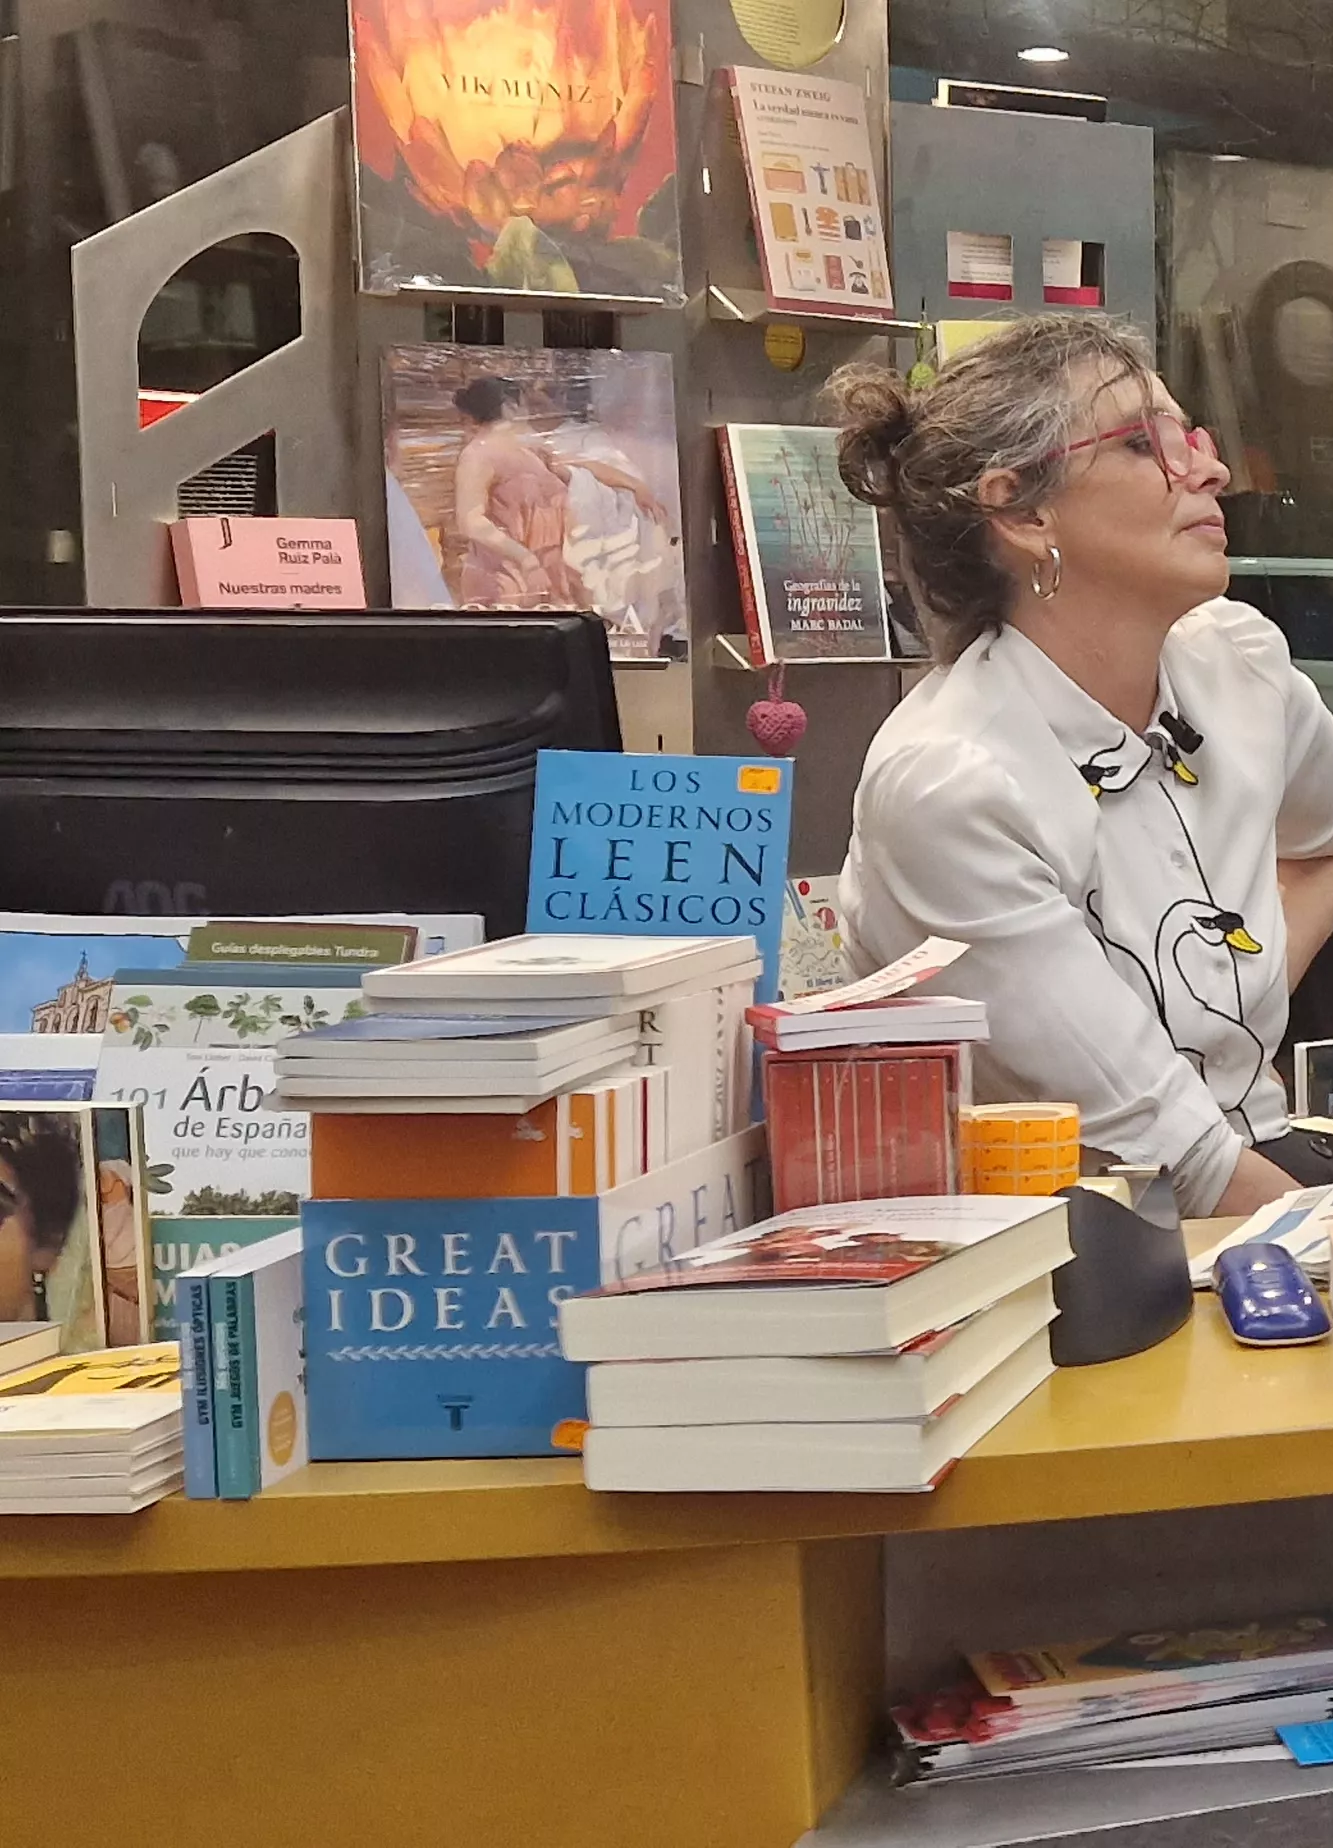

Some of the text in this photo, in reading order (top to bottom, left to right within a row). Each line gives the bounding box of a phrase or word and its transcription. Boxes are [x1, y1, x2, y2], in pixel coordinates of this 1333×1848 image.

[442, 73, 592, 104] VIK MUNIZ
[276, 537, 333, 550] Gemma
[279, 552, 309, 565] Ruiz
[219, 582, 342, 595] Nuestras madres
[787, 594, 863, 616] ingravidez
[791, 620, 864, 631] MARC BADAL
[630, 770, 701, 794] LOS
[552, 801, 772, 832] MODERNOS
[549, 837, 767, 886] LEEN
[545, 886, 766, 926] CLÁSICOS
[334, 944, 379, 958] Tundra
[173, 1116, 307, 1145] de España
[171, 1145, 267, 1162] que hay que
[325, 1229, 579, 1278] GREAT
[226, 1281, 240, 1336] PALABRAS
[228, 1338, 240, 1355] DE
[231, 1403, 243, 1428] GYM
